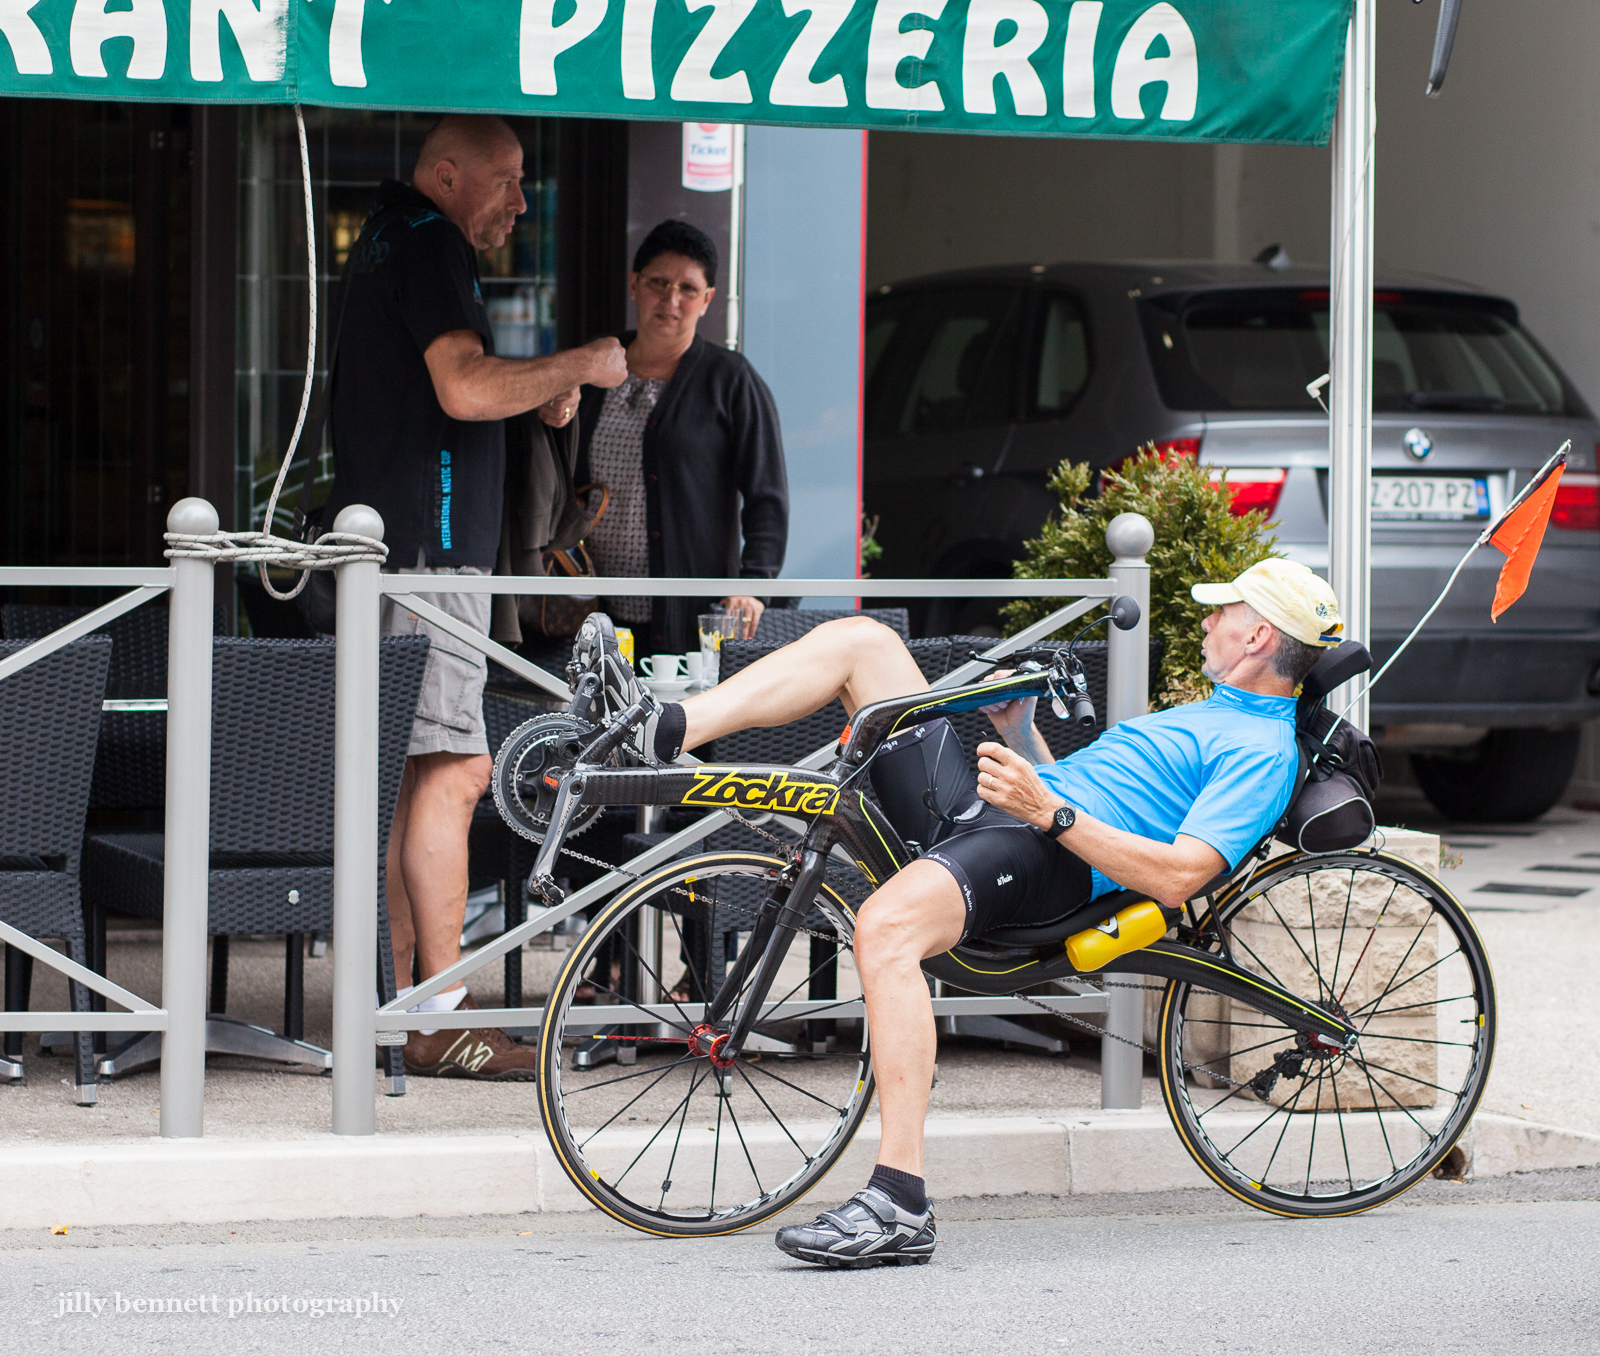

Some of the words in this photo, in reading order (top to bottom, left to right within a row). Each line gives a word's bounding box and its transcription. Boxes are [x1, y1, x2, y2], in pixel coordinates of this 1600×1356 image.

[518, 0, 1199, 121] PIZZERIA
[690, 143, 727, 155] Ticket
[440, 449, 451, 465] CUP
[441, 466, 452, 493] NAUTIC
[441, 495, 452, 549] INTERNATIONAL
[681, 766, 840, 815] Zockra
